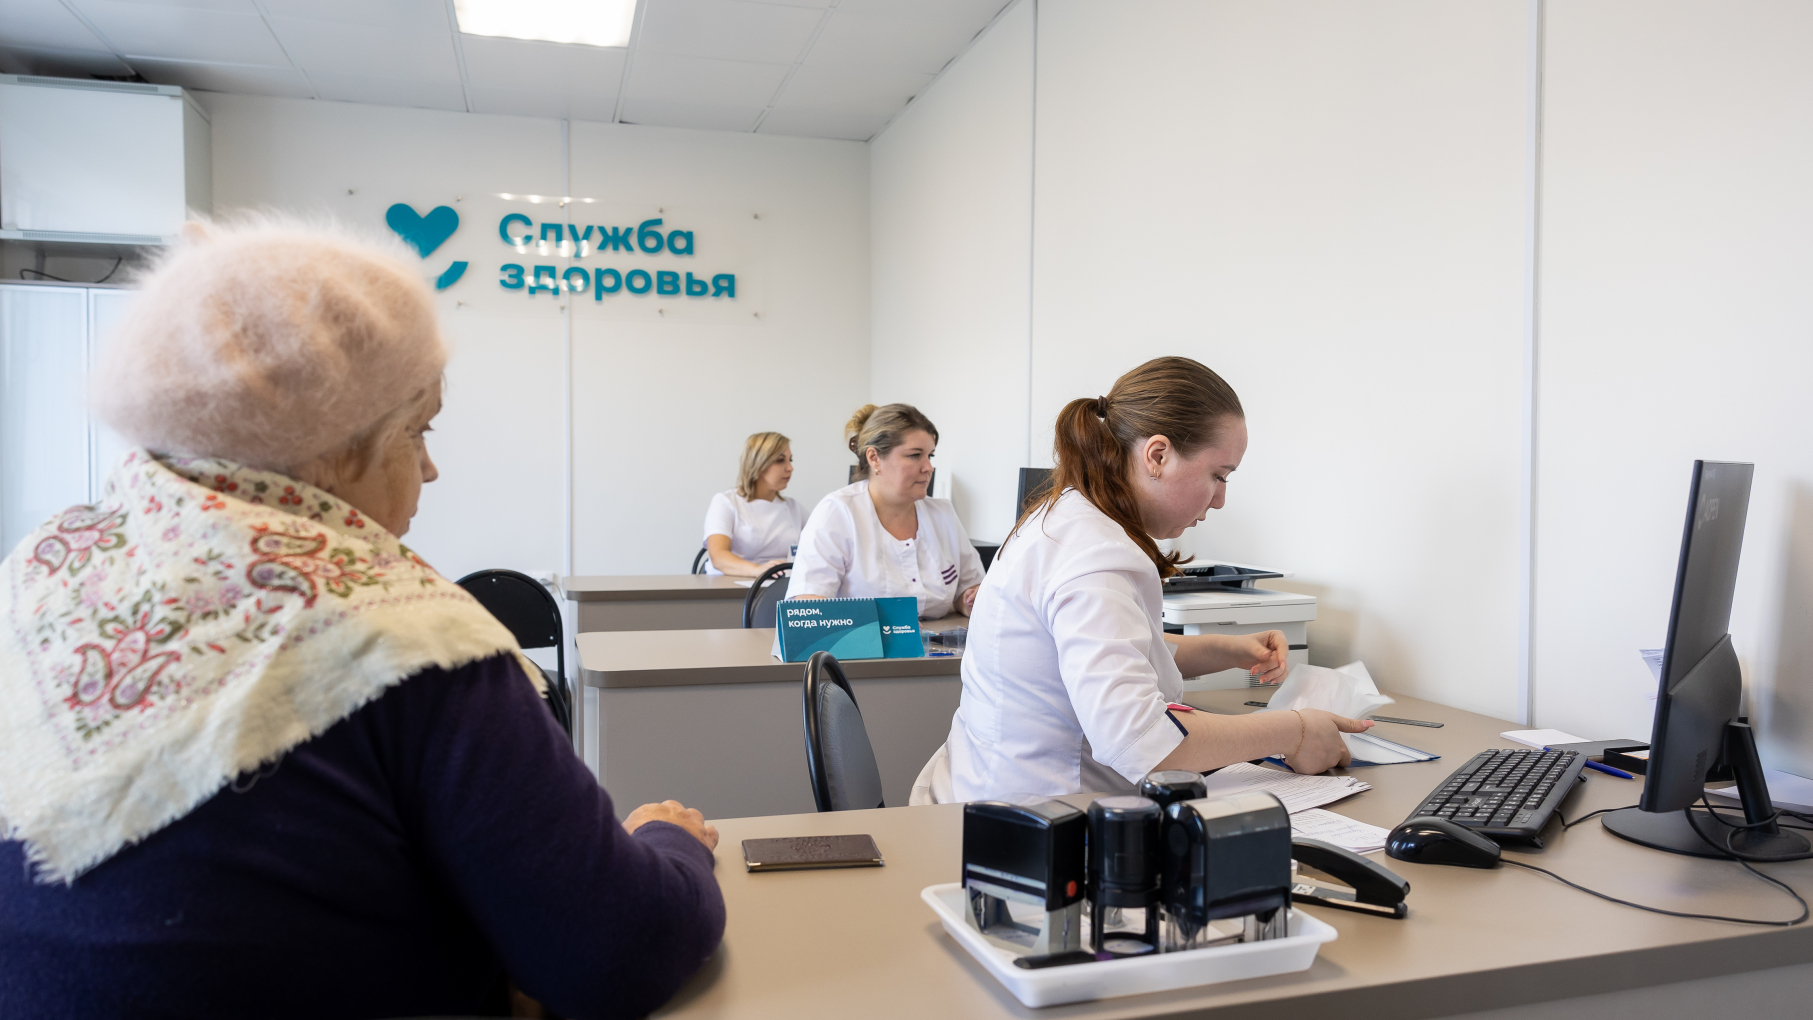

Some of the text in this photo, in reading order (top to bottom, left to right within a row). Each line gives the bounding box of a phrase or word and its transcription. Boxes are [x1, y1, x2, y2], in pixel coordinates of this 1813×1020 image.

[499, 213, 694, 258] Служба
[499, 263, 736, 301] здоровья
[786, 608, 823, 617] рядом,
[788, 618, 853, 629] когда нужно
